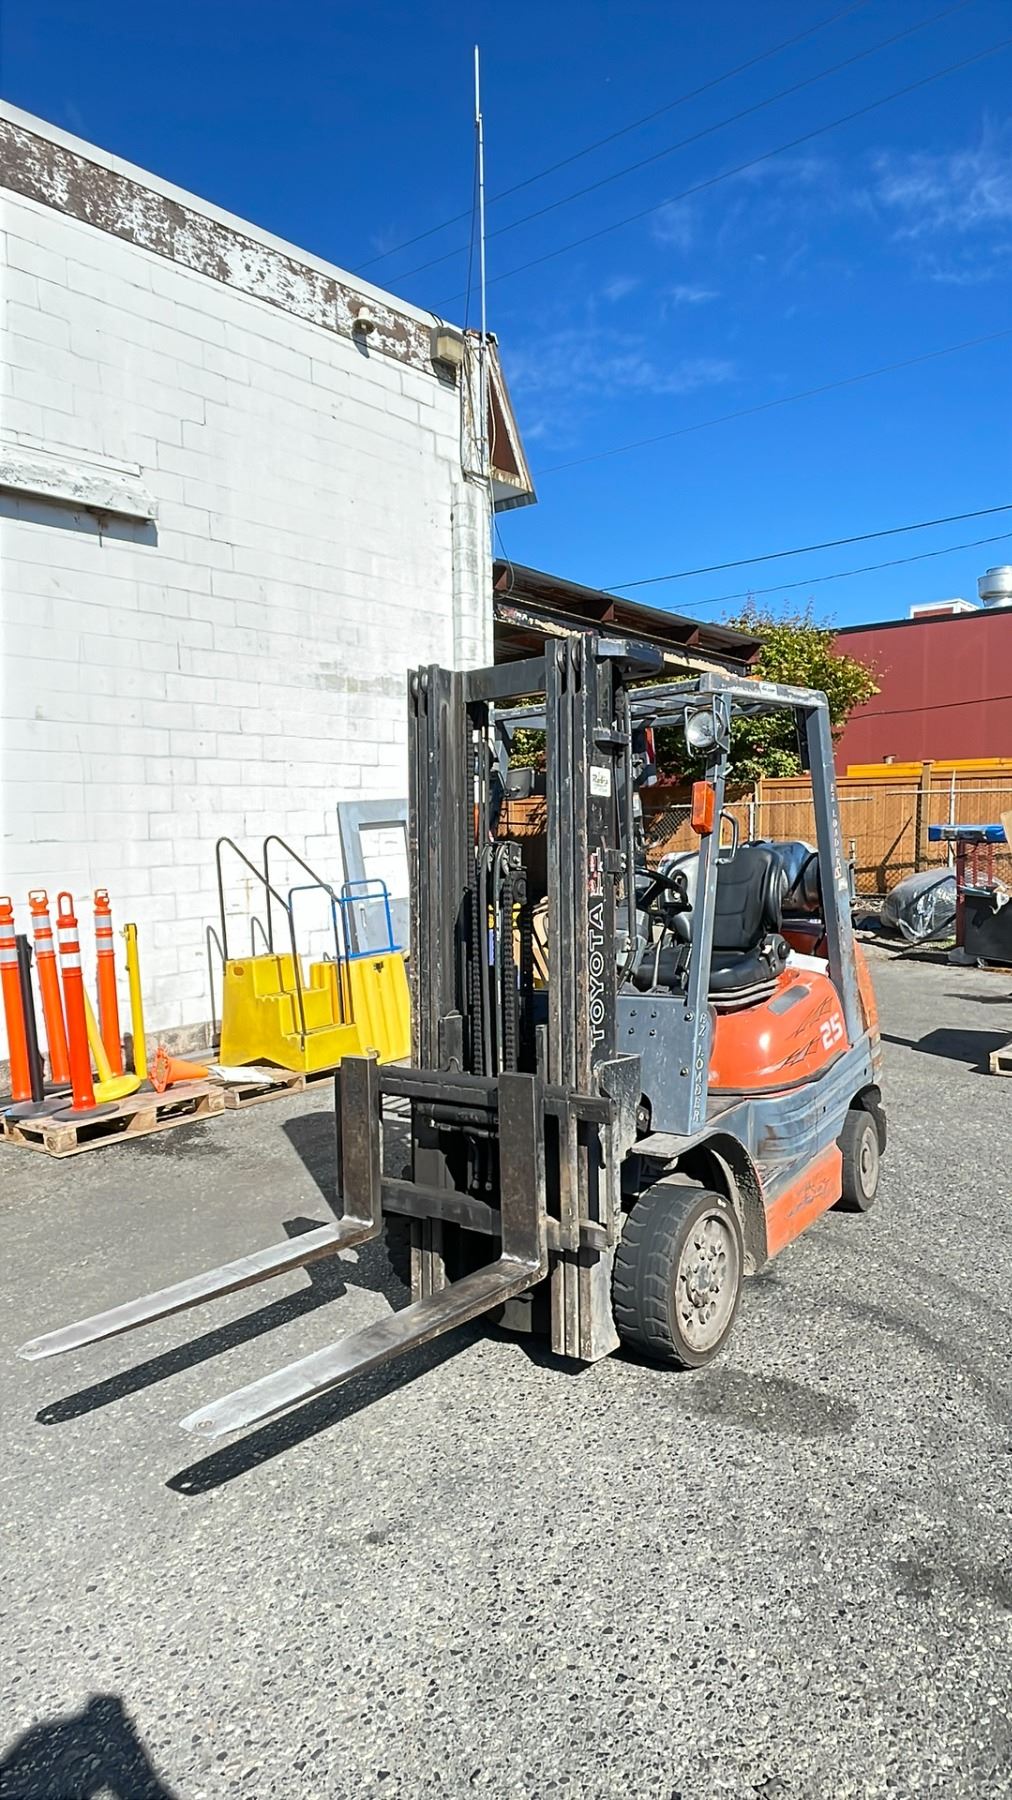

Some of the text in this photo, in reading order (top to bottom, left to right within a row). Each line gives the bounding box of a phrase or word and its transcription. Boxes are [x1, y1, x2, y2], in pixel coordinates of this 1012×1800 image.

[588, 902, 605, 1051] TOYOTA
[820, 1011, 843, 1051] 25
[693, 1044, 704, 1122] LOADER
